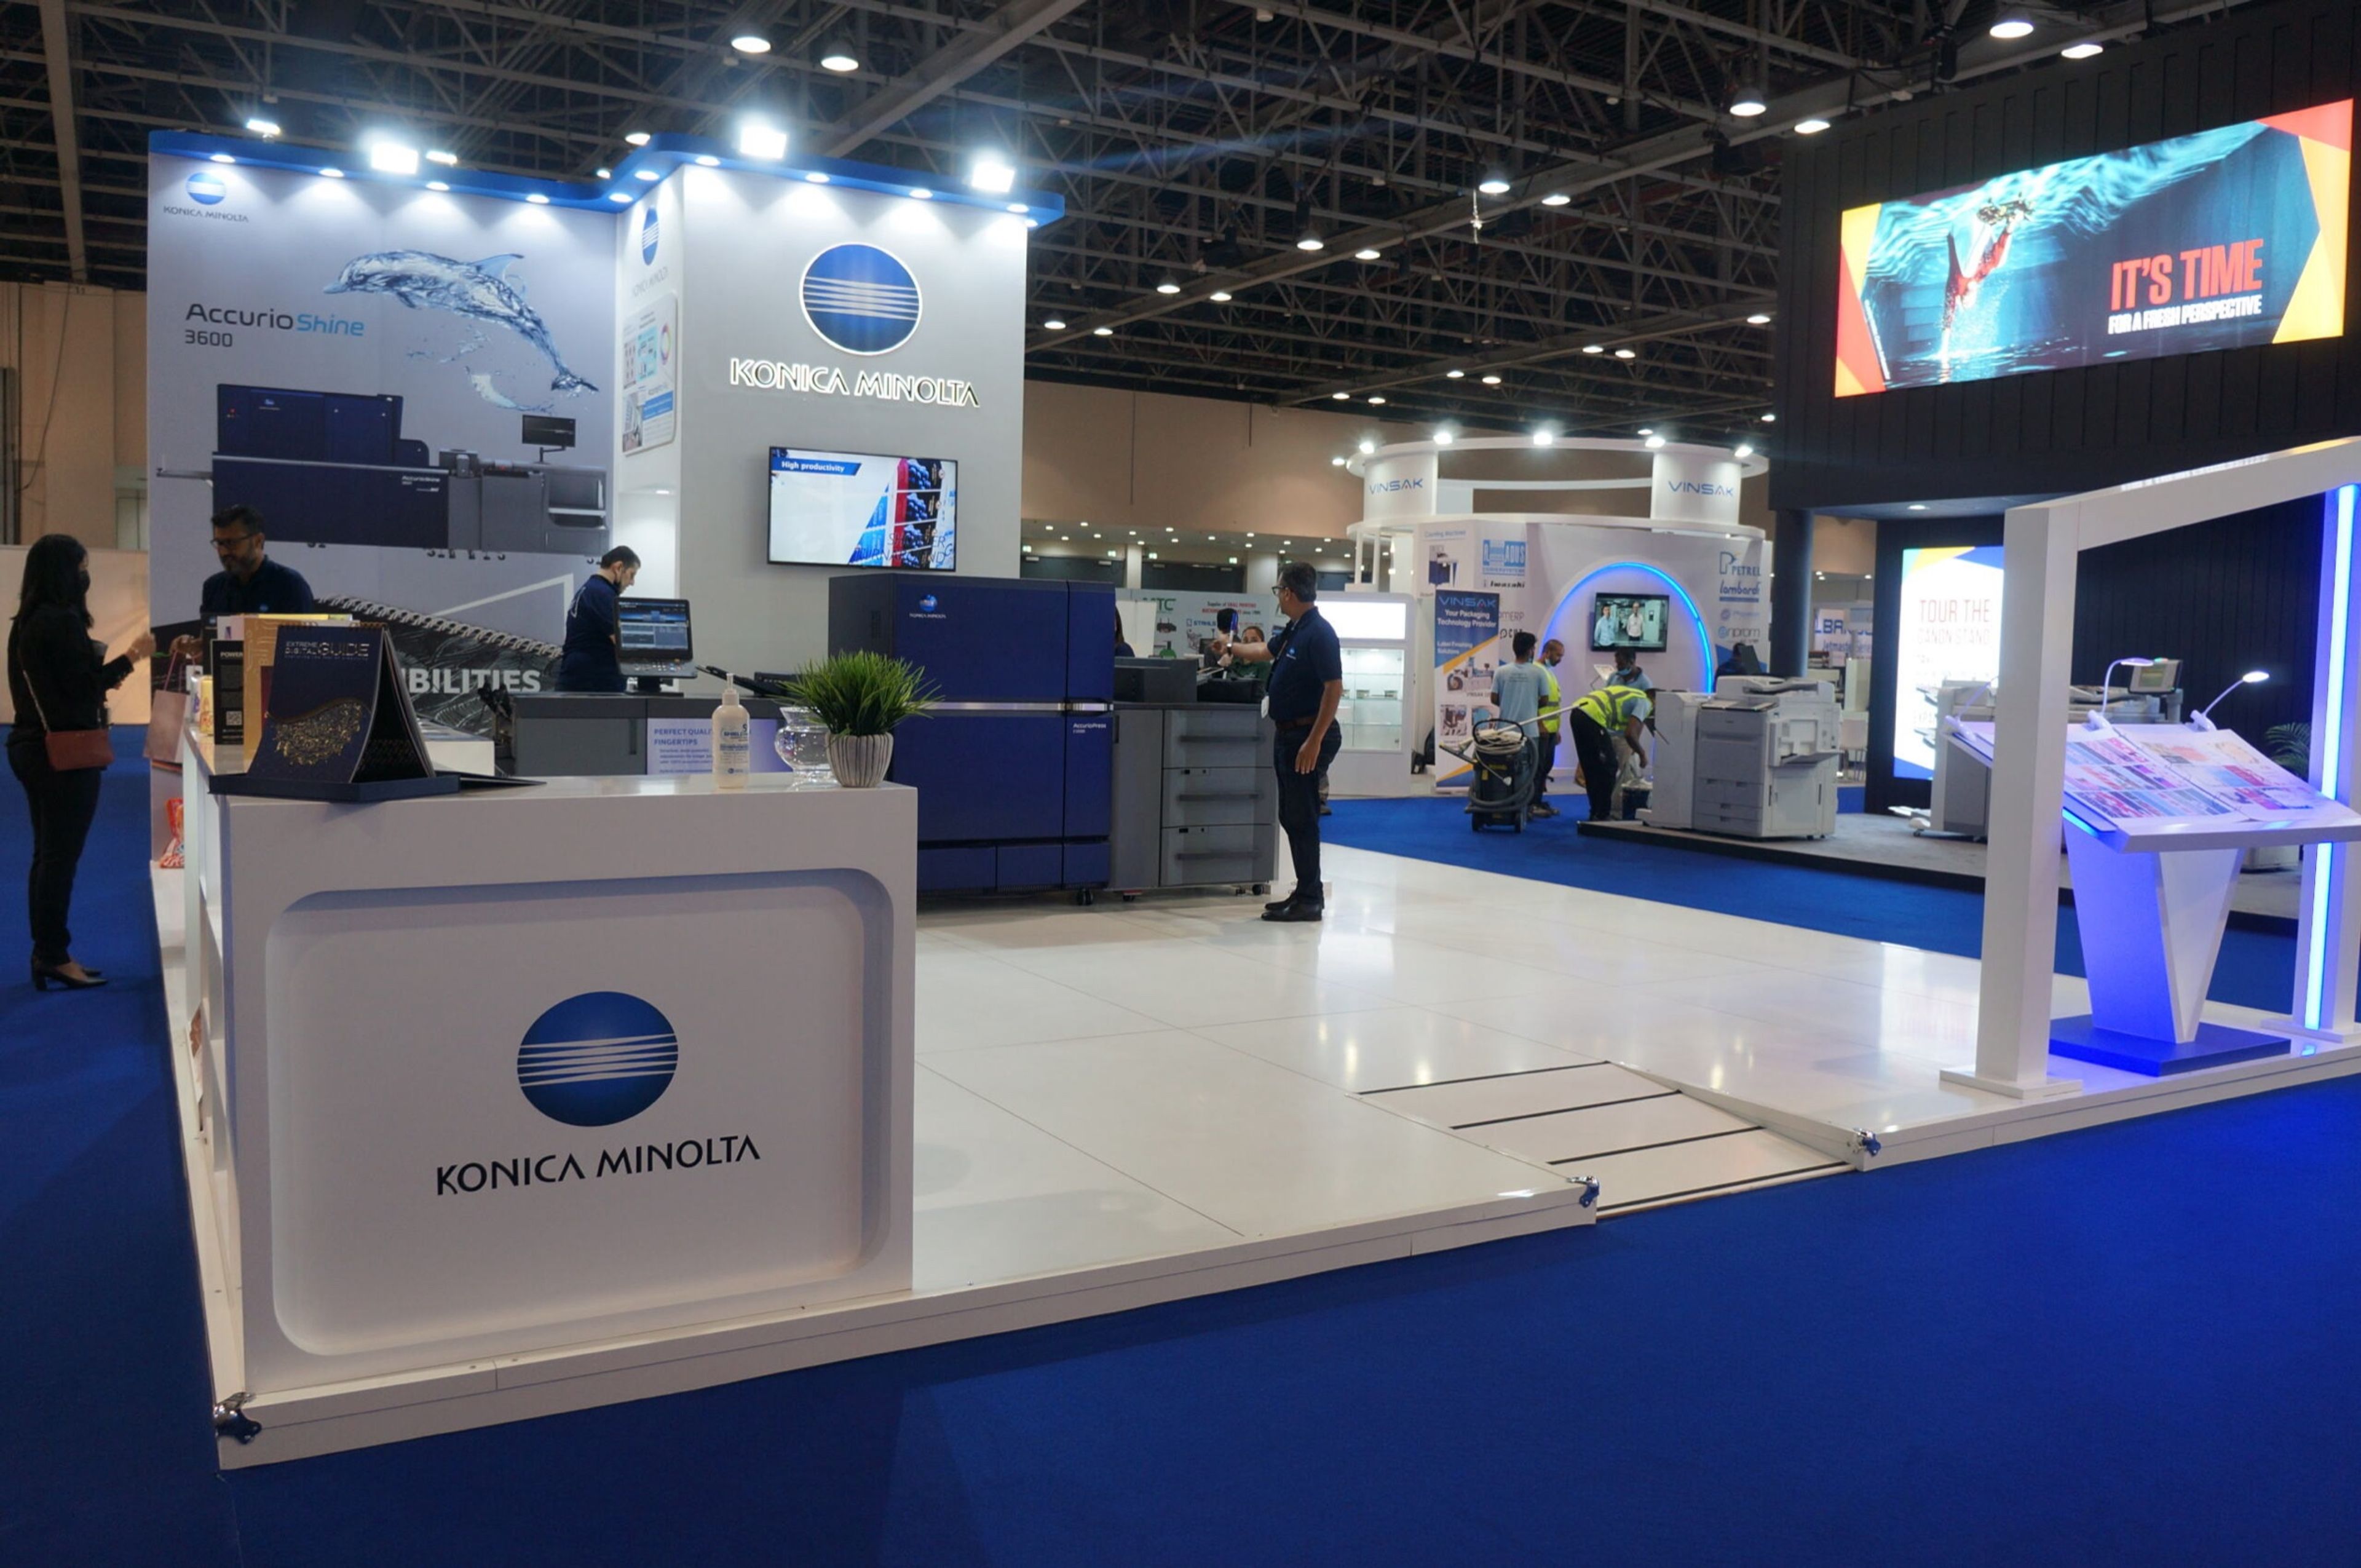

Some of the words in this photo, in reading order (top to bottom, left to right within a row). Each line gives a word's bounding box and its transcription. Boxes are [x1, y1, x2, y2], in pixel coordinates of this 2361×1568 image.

[163, 205, 203, 217] KONICA
[205, 212, 249, 222] MINOLTA
[2110, 253, 2173, 311] IT'S
[2180, 238, 2264, 301] TIME
[186, 303, 365, 336] AccurioShine
[2107, 312, 2132, 335] FOR
[2132, 311, 2143, 331] A
[2143, 305, 2181, 330] FRESH
[2181, 294, 2263, 325] PERSPECTIVE
[185, 329, 233, 347] 3600
[730, 357, 850, 395] KONICA
[854, 370, 980, 407] MINOLTA
[781, 461, 799, 470] High
[801, 462, 845, 473] productivity
[1369, 478, 1423, 495] VINSAK
[1667, 480, 1734, 497] VINSAK
[1438, 596, 1497, 608] VINSAK
[1920, 599, 1958, 623] TOUR
[1964, 598, 1991, 622] THE
[1437, 618, 1471, 628] Technology
[1460, 610, 1490, 620] Packaging
[435, 1154, 586, 1196] KONICA
[595, 1134, 762, 1178] MINOLTA
